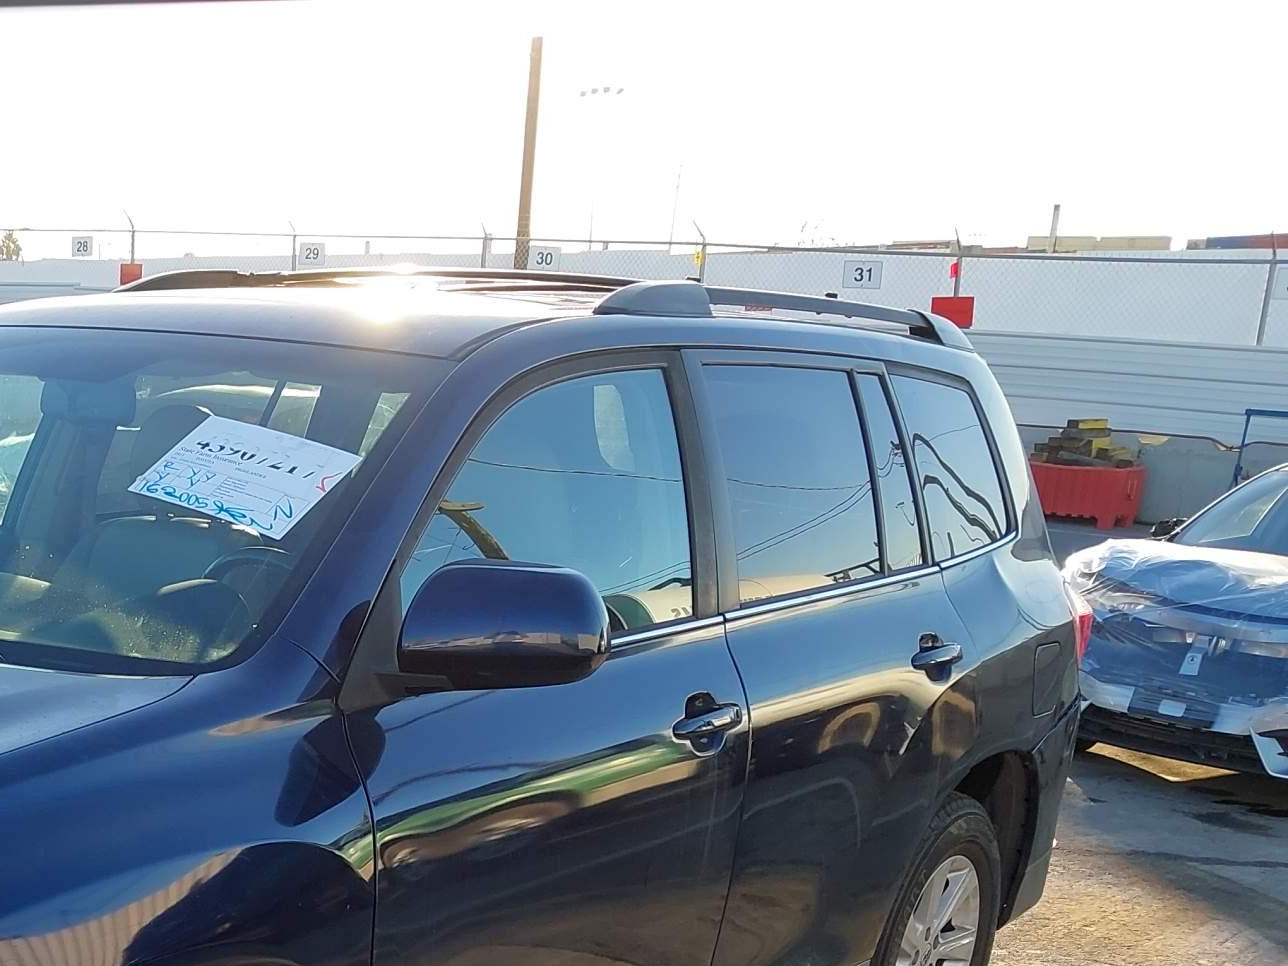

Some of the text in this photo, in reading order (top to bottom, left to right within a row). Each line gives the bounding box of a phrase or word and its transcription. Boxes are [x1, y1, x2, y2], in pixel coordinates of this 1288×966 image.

[76, 240, 89, 252] 28
[304, 247, 320, 260] 29
[535, 251, 554, 266] 30
[853, 267, 873, 282] 31
